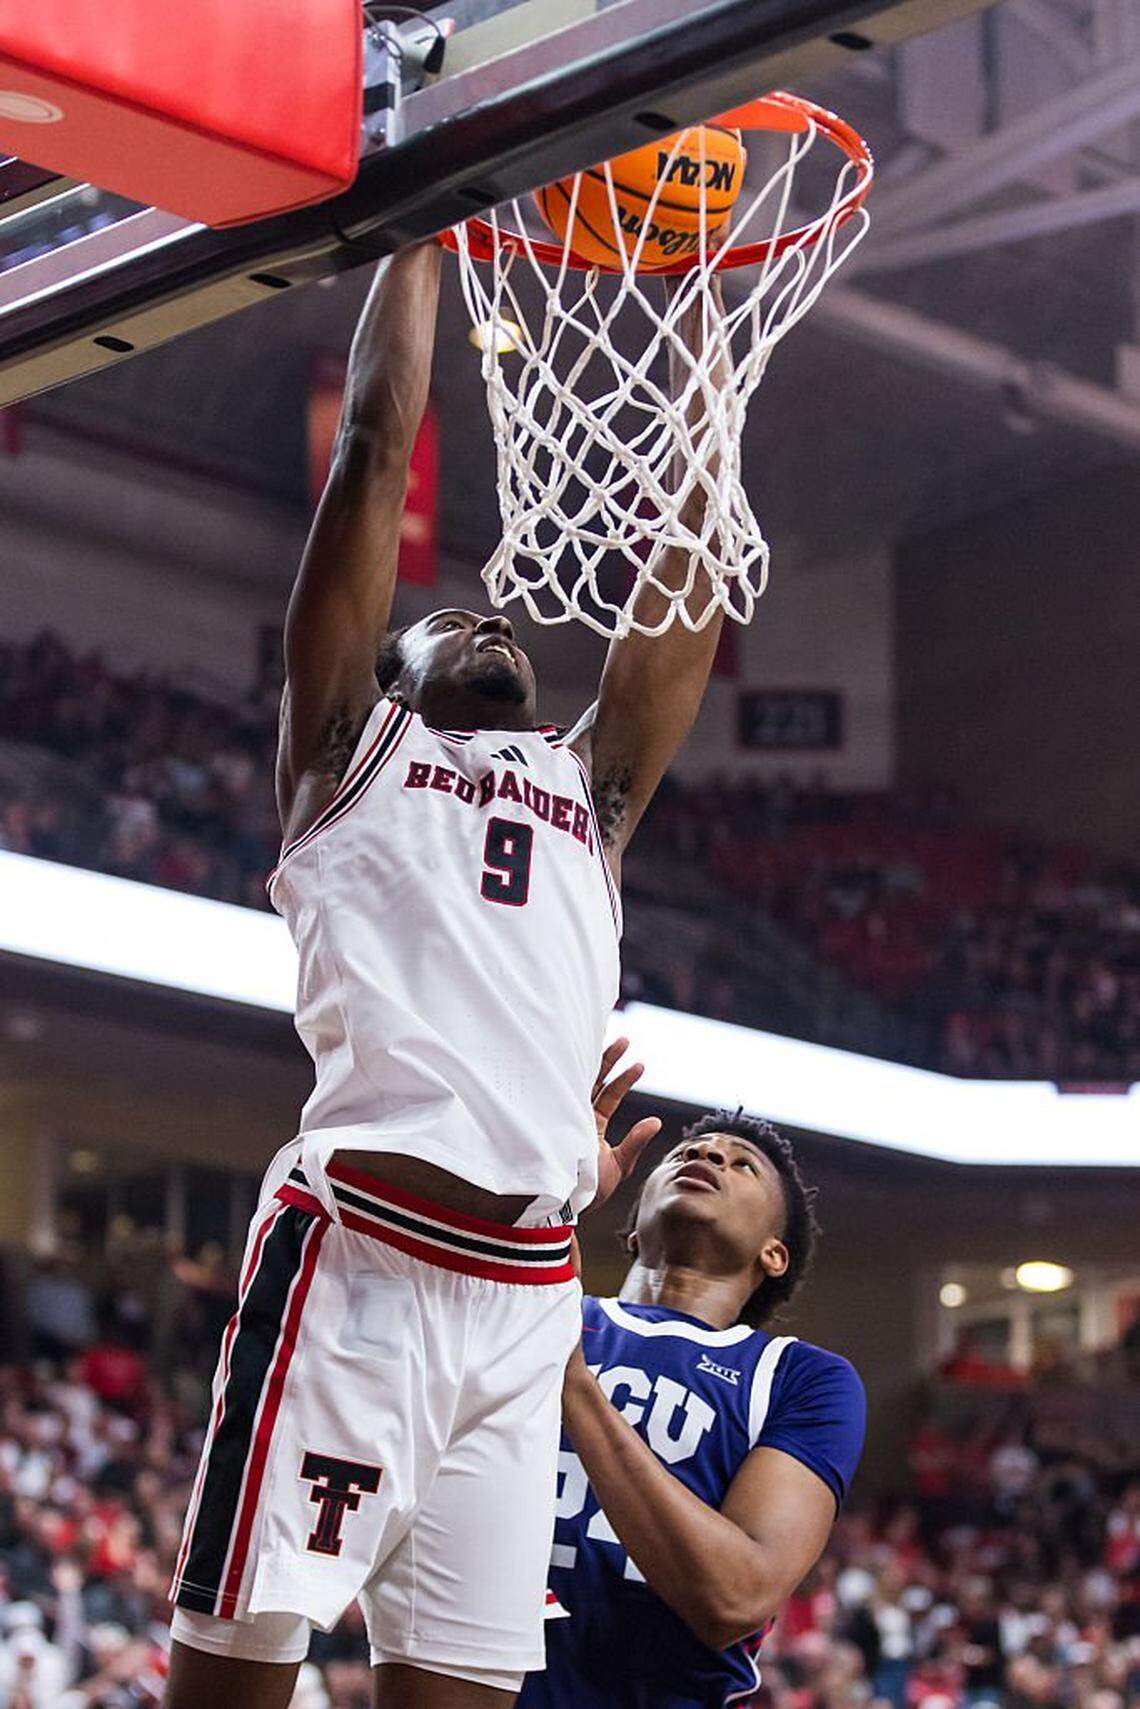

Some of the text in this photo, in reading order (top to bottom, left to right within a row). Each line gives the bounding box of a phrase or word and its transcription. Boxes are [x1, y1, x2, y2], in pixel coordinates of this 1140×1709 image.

[657, 151, 736, 192] NCAA
[403, 760, 595, 857] RED RAIDER
[480, 815, 535, 907] 9
[586, 1364, 717, 1465] CU
